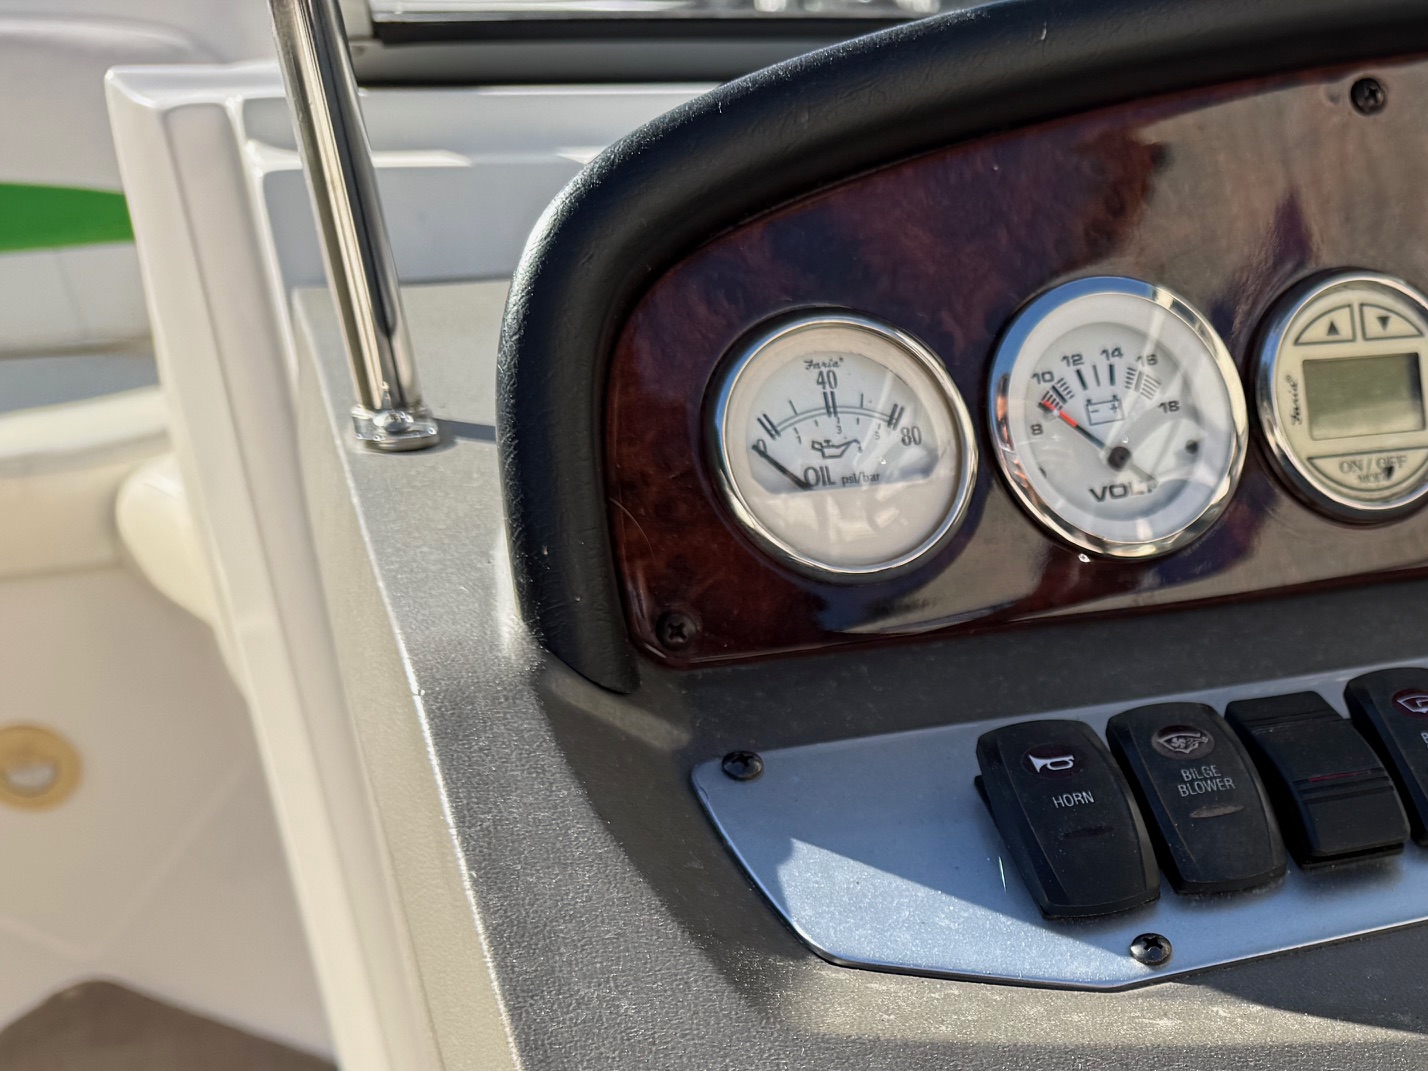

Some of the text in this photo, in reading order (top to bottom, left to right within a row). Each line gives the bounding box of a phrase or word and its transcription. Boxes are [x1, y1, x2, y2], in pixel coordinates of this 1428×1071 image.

[1061, 354, 1084, 368] 12
[1101, 347, 1124, 361] 14
[816, 370, 838, 389] 40
[1032, 371, 1055, 385] 10
[1158, 400, 1180, 413] 18
[901, 426, 922, 447] 80
[1031, 424, 1043, 436] 8
[804, 466, 837, 487] OIL
[1180, 765, 1221, 782] BILGE
[1177, 777, 1236, 798] BLOWER
[1052, 791, 1096, 809] HORN
